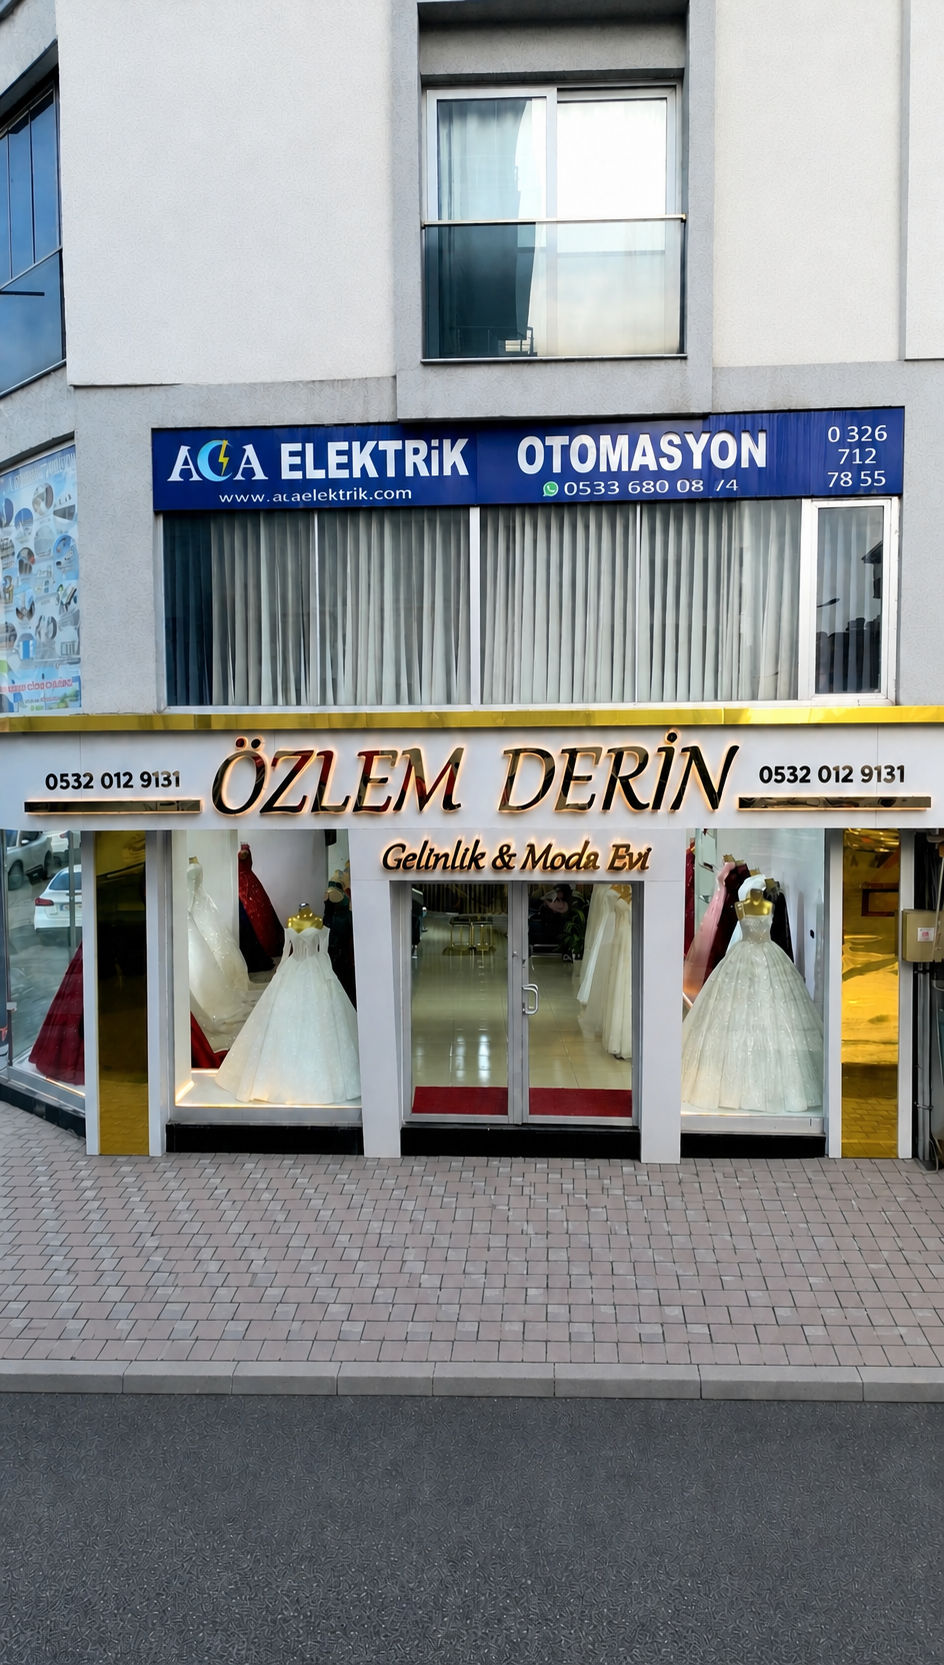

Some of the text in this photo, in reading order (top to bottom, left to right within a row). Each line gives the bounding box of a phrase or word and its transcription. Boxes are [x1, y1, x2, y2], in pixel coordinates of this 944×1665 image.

[828, 425, 887, 442] 0 326
[517, 430, 767, 475] OTOMASYON
[838, 448, 876, 464] 712
[564, 481, 620, 496] 0533
[628, 479, 669, 494] 680
[676, 479, 704, 493] 08
[827, 470, 886, 487] 78 55
[45, 771, 181, 790] 0532 012 9131
[212, 731, 740, 815] ÖZLEM DERİN
[759, 765, 906, 784] 0532 012 9131
[383, 837, 653, 871] Gelinlik & Moda Evi
